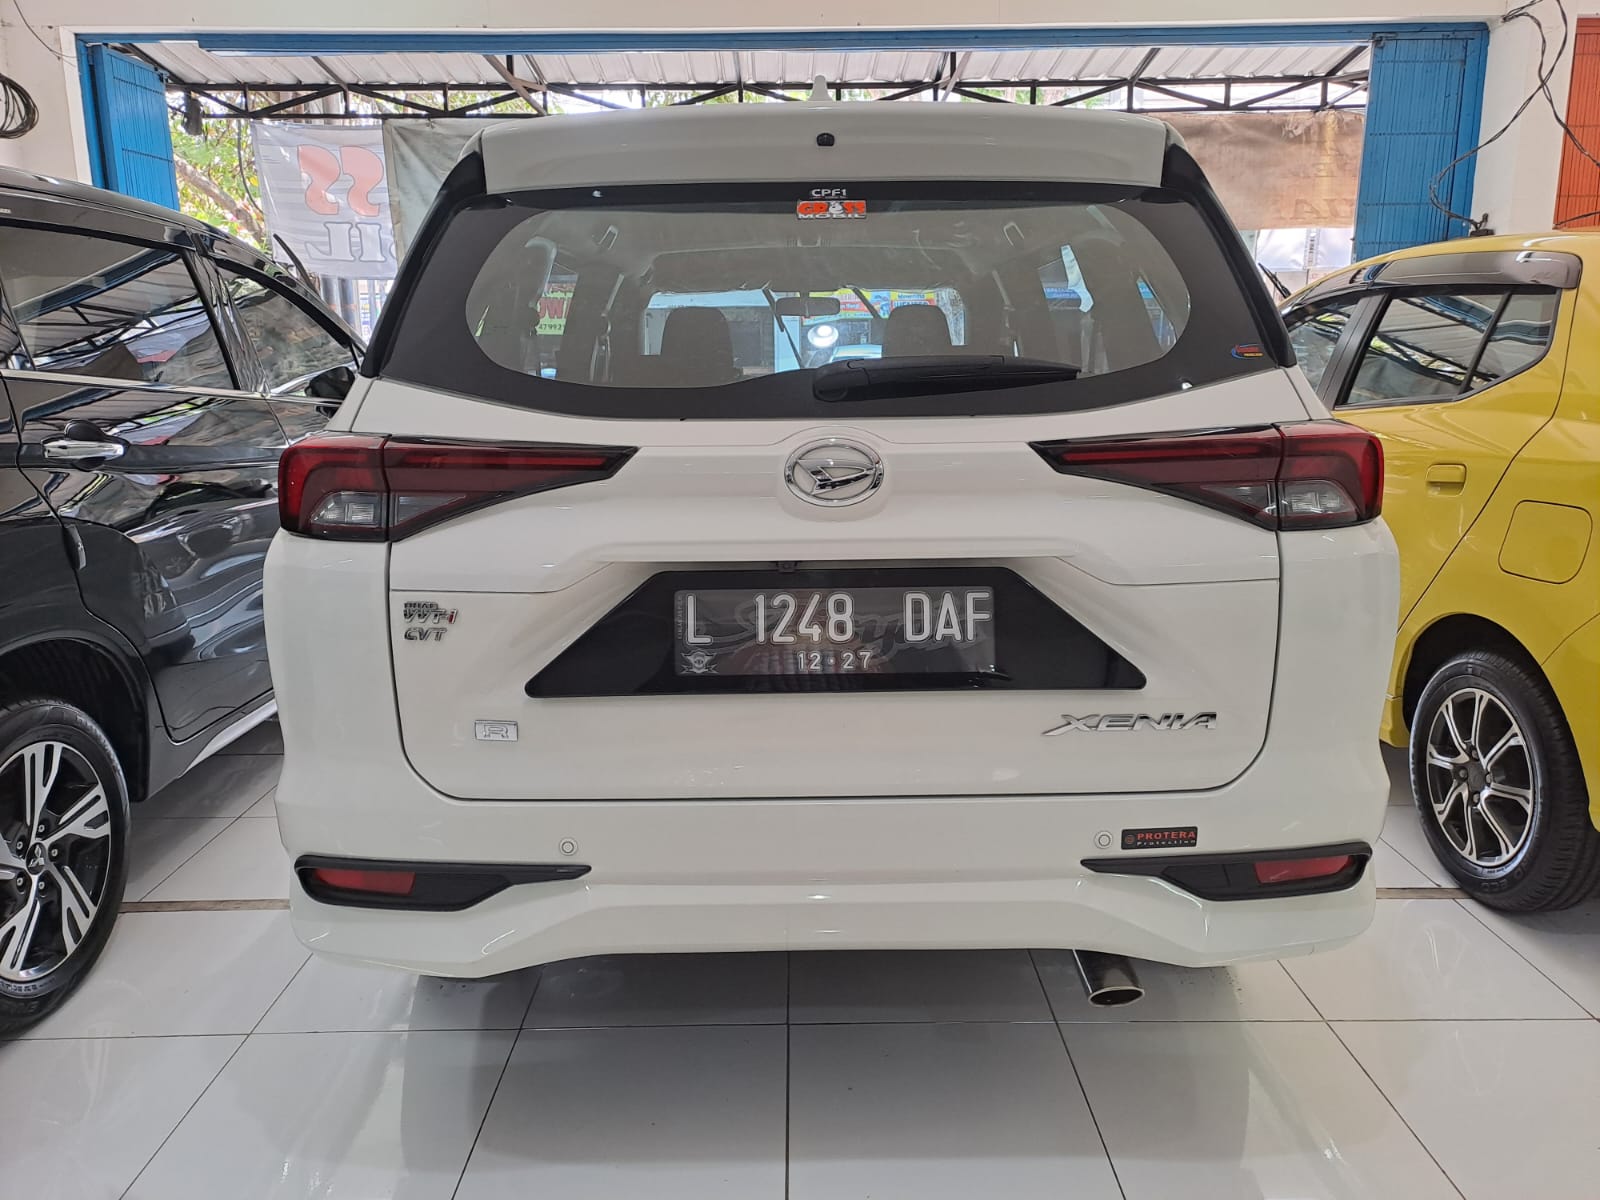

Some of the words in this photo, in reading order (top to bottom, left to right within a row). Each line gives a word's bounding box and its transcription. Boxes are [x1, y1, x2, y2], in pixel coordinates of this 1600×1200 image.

[811, 188, 847, 197] CPF1
[403, 609, 458, 624] VVT-i
[686, 593, 713, 645] L
[754, 592, 855, 645] 1248
[904, 590, 993, 643] DAF
[404, 627, 447, 641] CVT
[1041, 711, 1218, 737] XENIA
[1137, 831, 1196, 841] PROTERA
